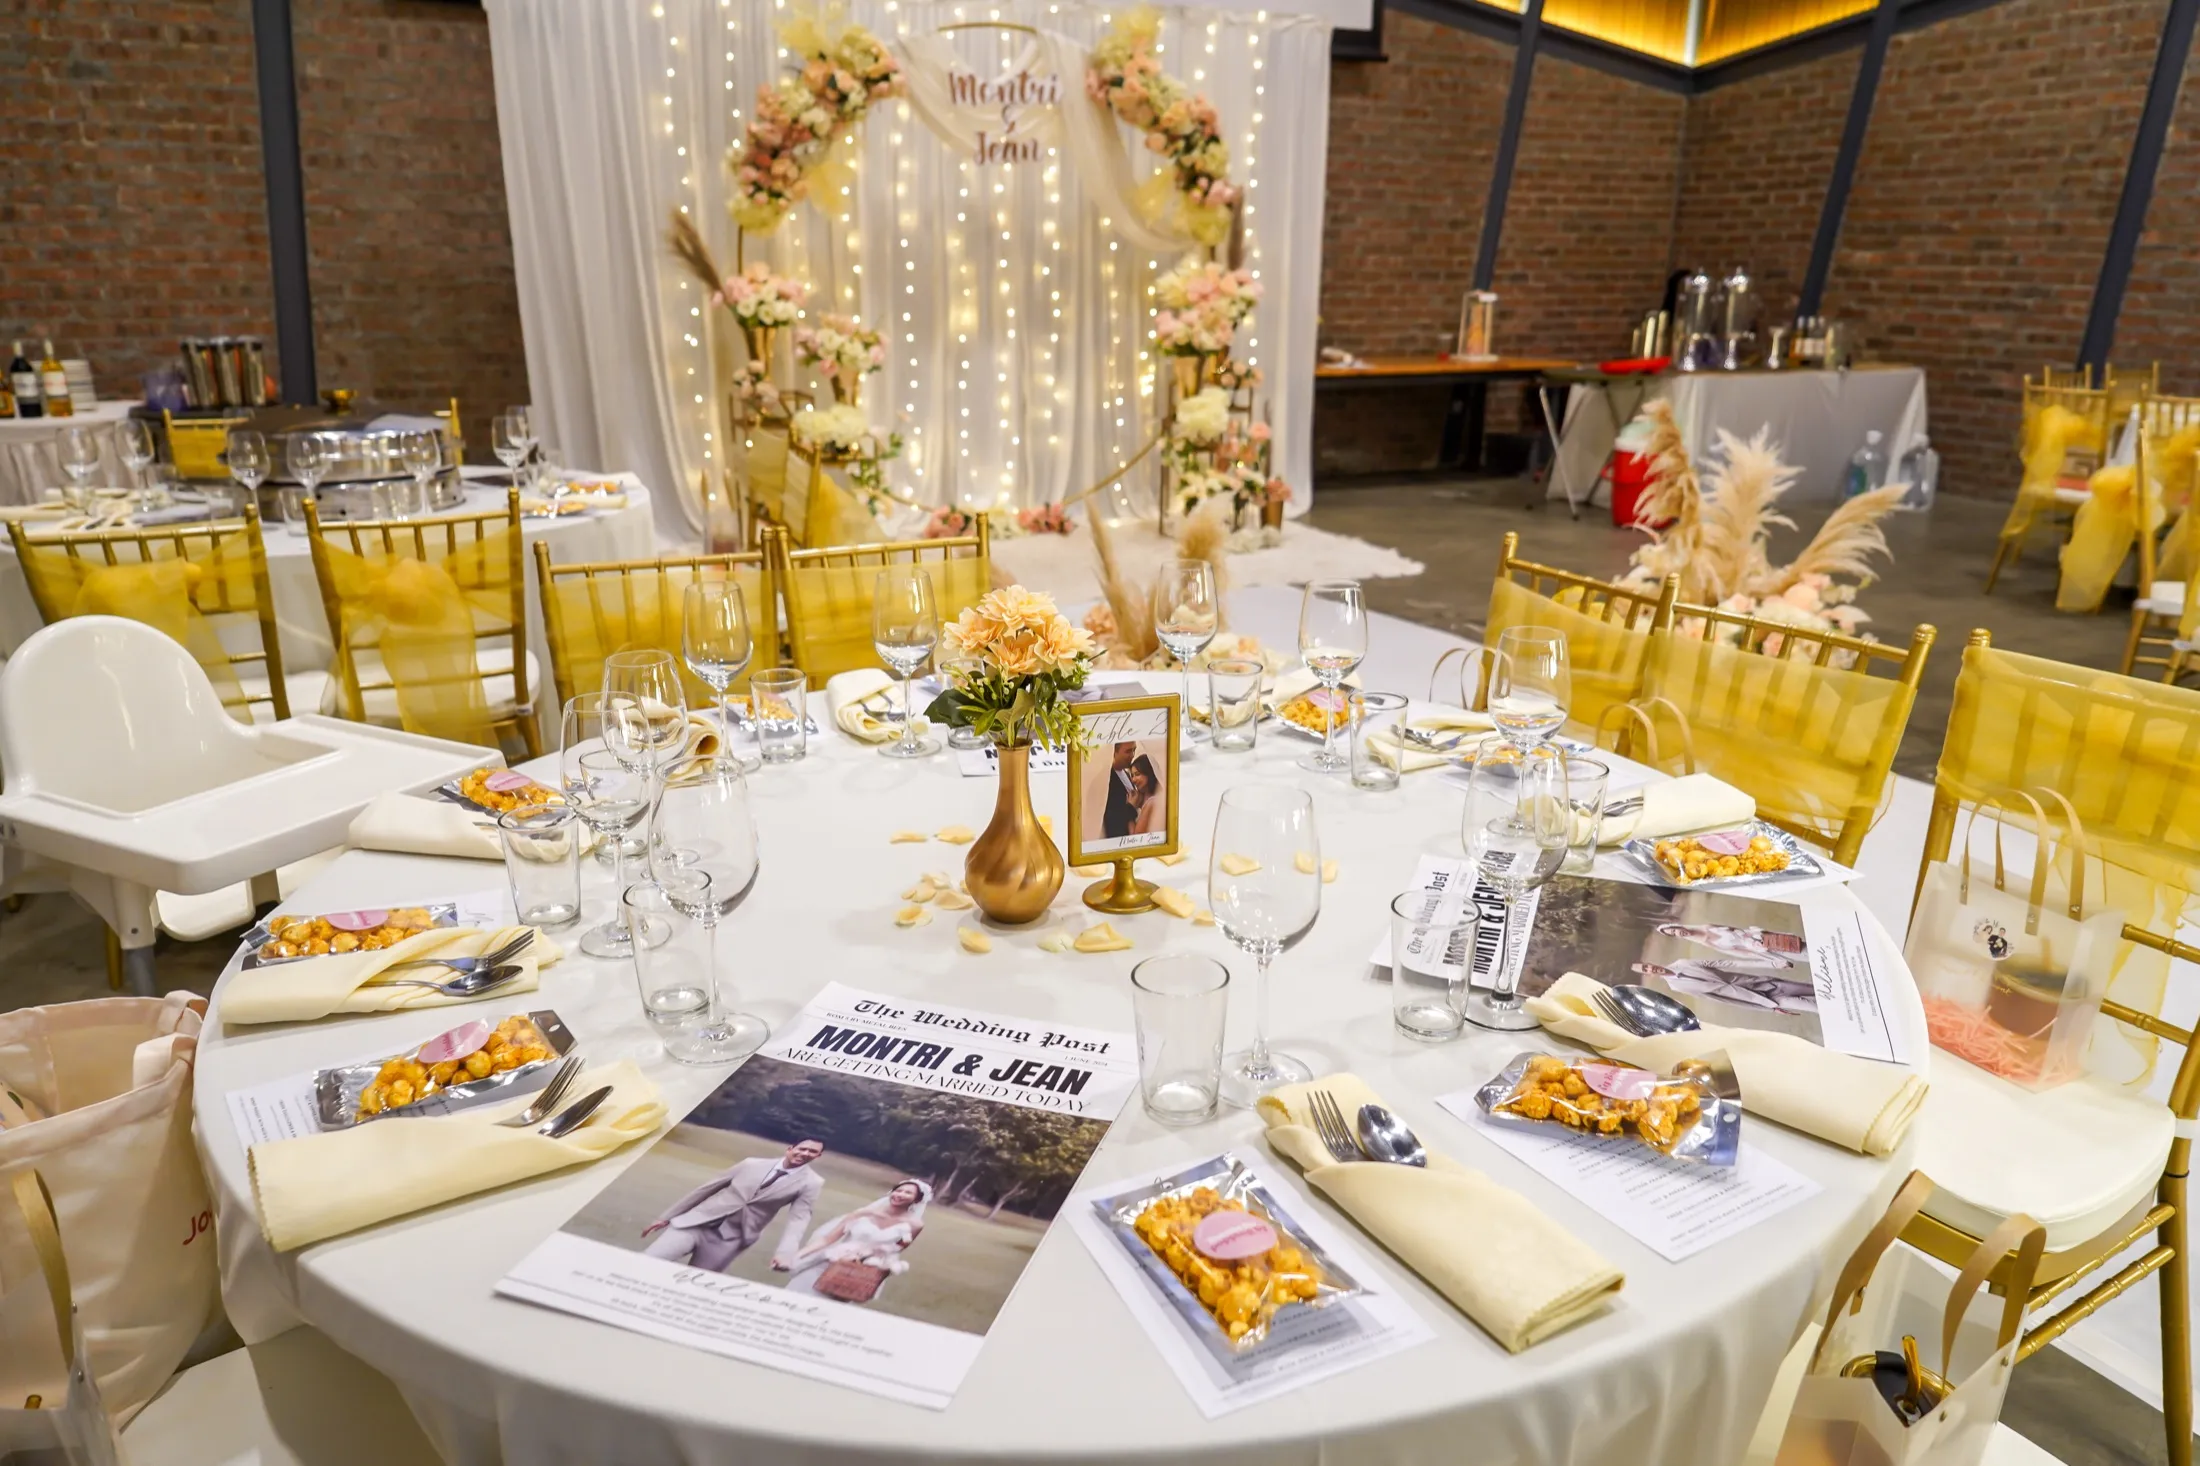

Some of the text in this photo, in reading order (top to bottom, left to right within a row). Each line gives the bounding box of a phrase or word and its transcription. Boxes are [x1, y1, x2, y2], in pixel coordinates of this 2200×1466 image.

[975, 131, 1038, 165] Jean
[854, 999, 1111, 1054] The Wedding Post
[777, 1047, 1092, 1112] ARE GETTING MARRIED TODAY
[805, 1024, 1093, 1096] MONTRI & JEAN
